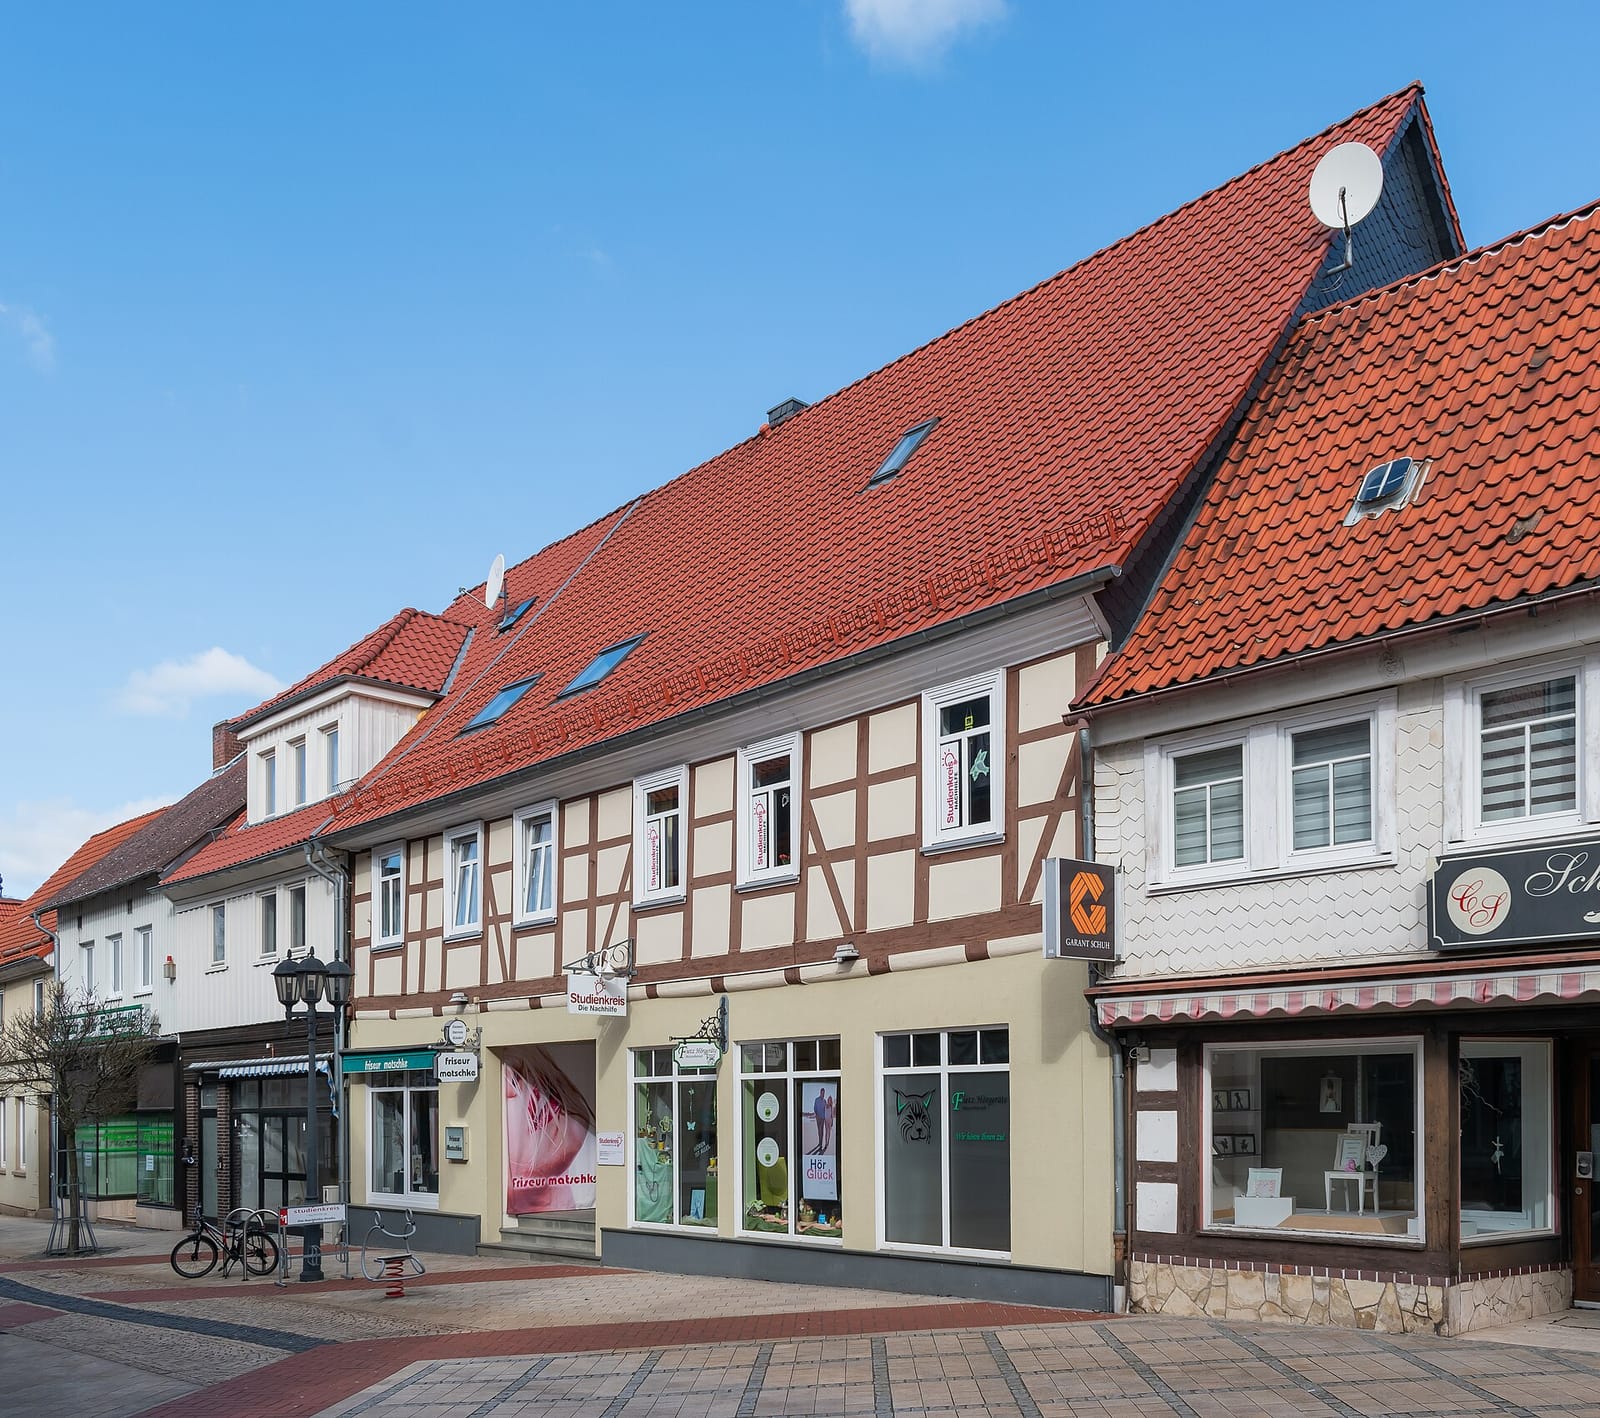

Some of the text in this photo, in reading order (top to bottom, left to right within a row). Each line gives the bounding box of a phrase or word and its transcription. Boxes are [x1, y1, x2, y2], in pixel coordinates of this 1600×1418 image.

[1065, 938, 1111, 950] GARANT SCHUH
[570, 992, 625, 1006] Studienkreis
[577, 1004, 618, 1013] Die Nachhilfe
[364, 1058, 409, 1070] friseur matschke
[444, 1057, 471, 1065] friseur
[439, 1068, 477, 1078] matschke
[810, 1159, 826, 1169] Hör
[806, 1168, 833, 1180] Glück
